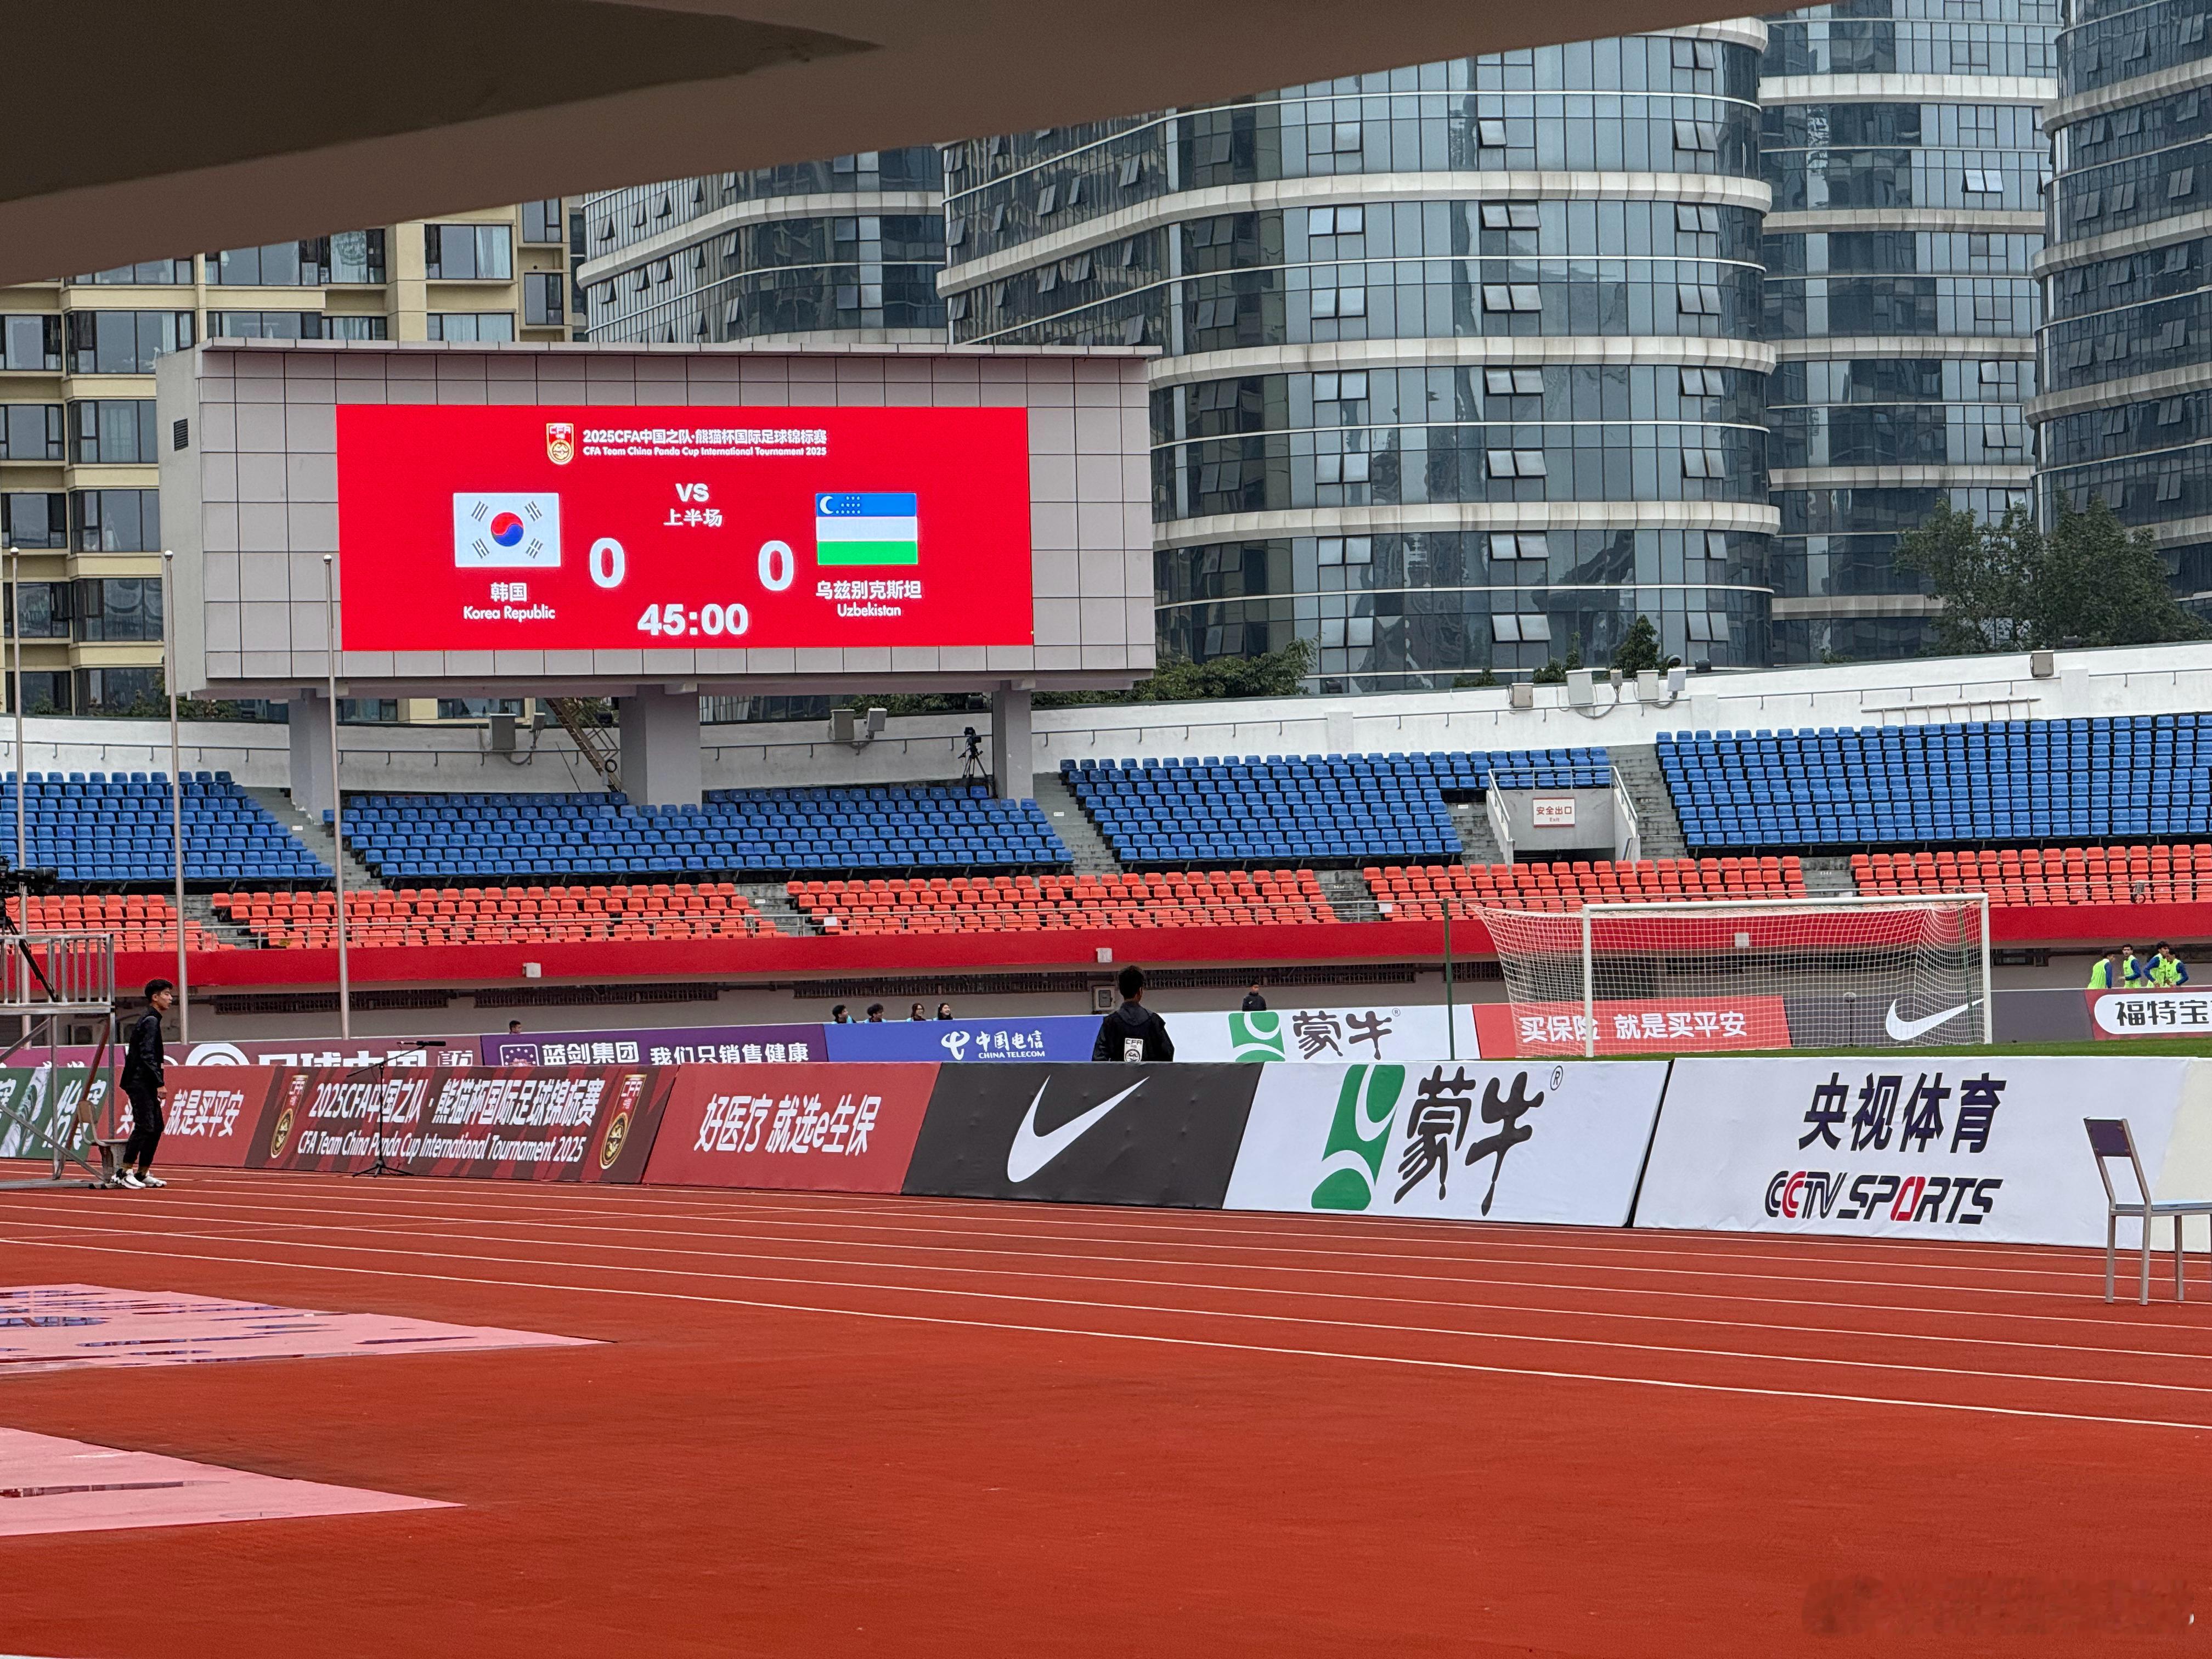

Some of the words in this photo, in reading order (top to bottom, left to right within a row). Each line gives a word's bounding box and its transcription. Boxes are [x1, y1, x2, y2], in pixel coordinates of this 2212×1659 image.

[583, 446, 601, 456] CFA
[603, 447, 626, 456] Team
[627, 446, 652, 456] China
[654, 446, 680, 456] Panda
[681, 447, 699, 458] Cup
[701, 446, 753, 456] International
[755, 447, 804, 456] Tournament
[805, 447, 827, 456] 2025
[675, 483, 710, 503] VS
[663, 508, 723, 527] 上半场
[589, 537, 625, 589] 0
[758, 540, 794, 591] 0
[490, 582, 528, 602] 韩国
[815, 580, 922, 600] 乌兹别克斯坦
[463, 605, 501, 620] Korea
[504, 603, 556, 623] Republic
[637, 603, 749, 636] 45:00
[837, 601, 901, 617] Uzbekistan
[1536, 806, 1572, 815] 安全出口
[976, 1030, 1044, 1052] 中国电信
[1292, 1010, 1392, 1060] 蒙牛
[1519, 1015, 1601, 1043] 买保险
[1613, 1011, 1747, 1040] 就是买平安
[542, 1041, 640, 1066] 蓝剑集团
[650, 1042, 810, 1065] 我们只销售健康
[163, 1088, 244, 1138] 就是买平安
[693, 1093, 773, 1153] 好医疗
[1798, 1071, 2007, 1154] 央视体育
[297, 1130, 319, 1154] CFA
[316, 1131, 343, 1155] Team
[342, 1130, 370, 1156] China
[400, 1132, 421, 1165] Cup
[419, 1132, 491, 1159] International
[487, 1135, 556, 1161] Tournament
[552, 1136, 587, 1163] 2025
[1393, 1064, 1545, 1217] 蒙牛
[1765, 1170, 1848, 1219] CCTV
[1836, 1175, 2004, 1225] SPORTS
